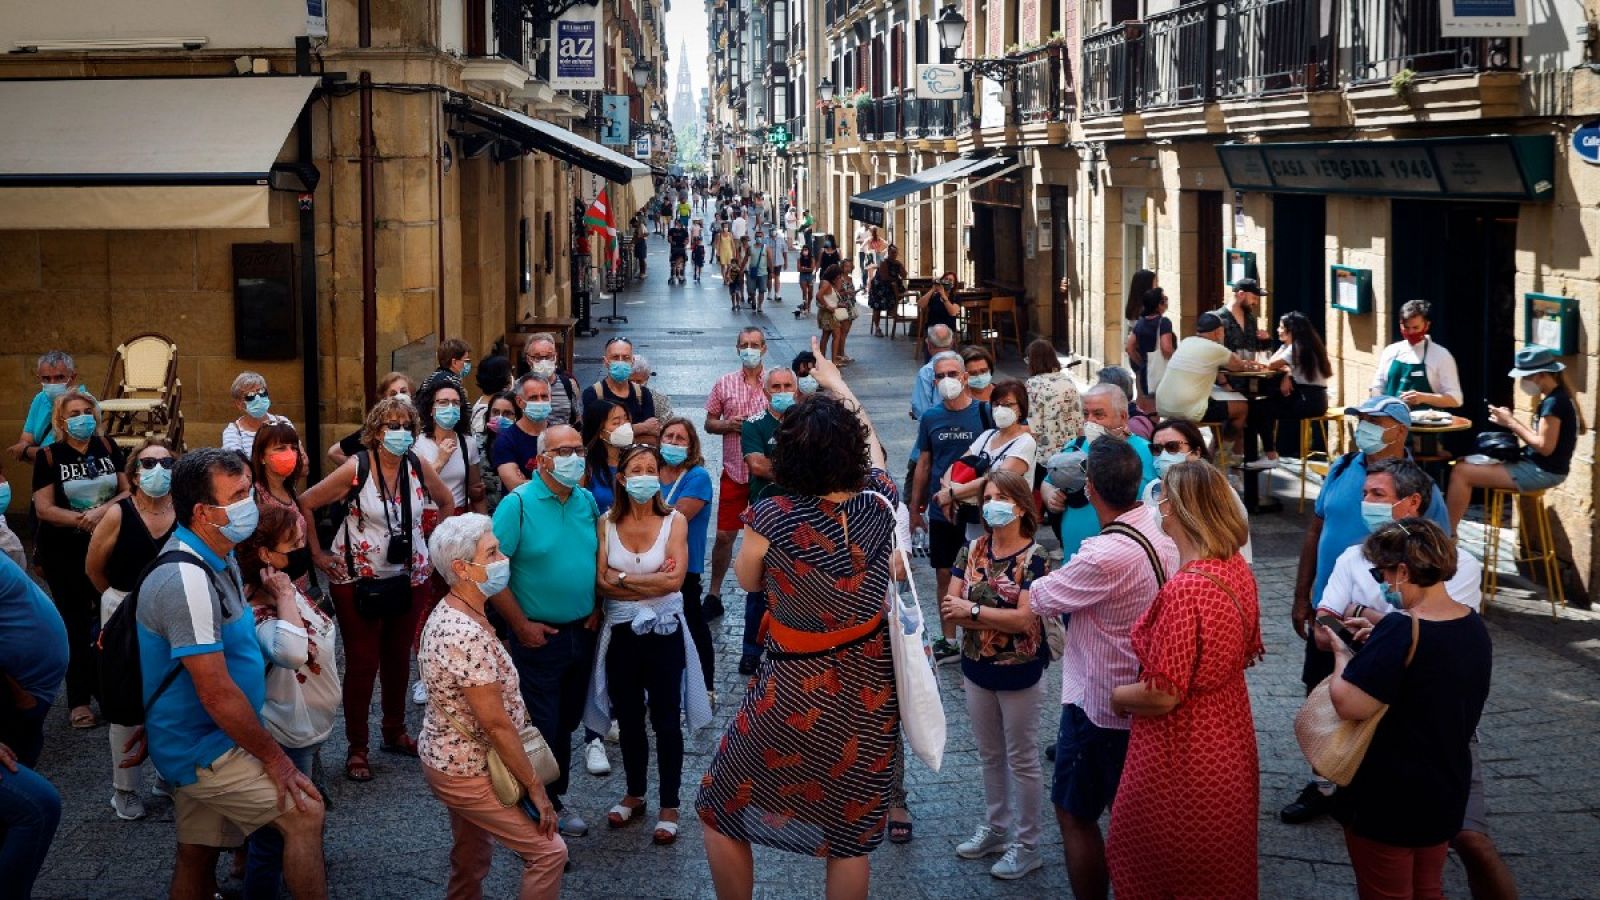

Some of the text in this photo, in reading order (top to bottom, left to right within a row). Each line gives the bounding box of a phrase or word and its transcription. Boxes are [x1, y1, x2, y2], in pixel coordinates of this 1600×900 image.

[560, 37, 593, 58] az
[1272, 159, 1307, 178] CASA
[1315, 160, 1385, 180] VERGARA
[1391, 159, 1432, 179] 1948
[938, 431, 974, 441] OPTIMIST
